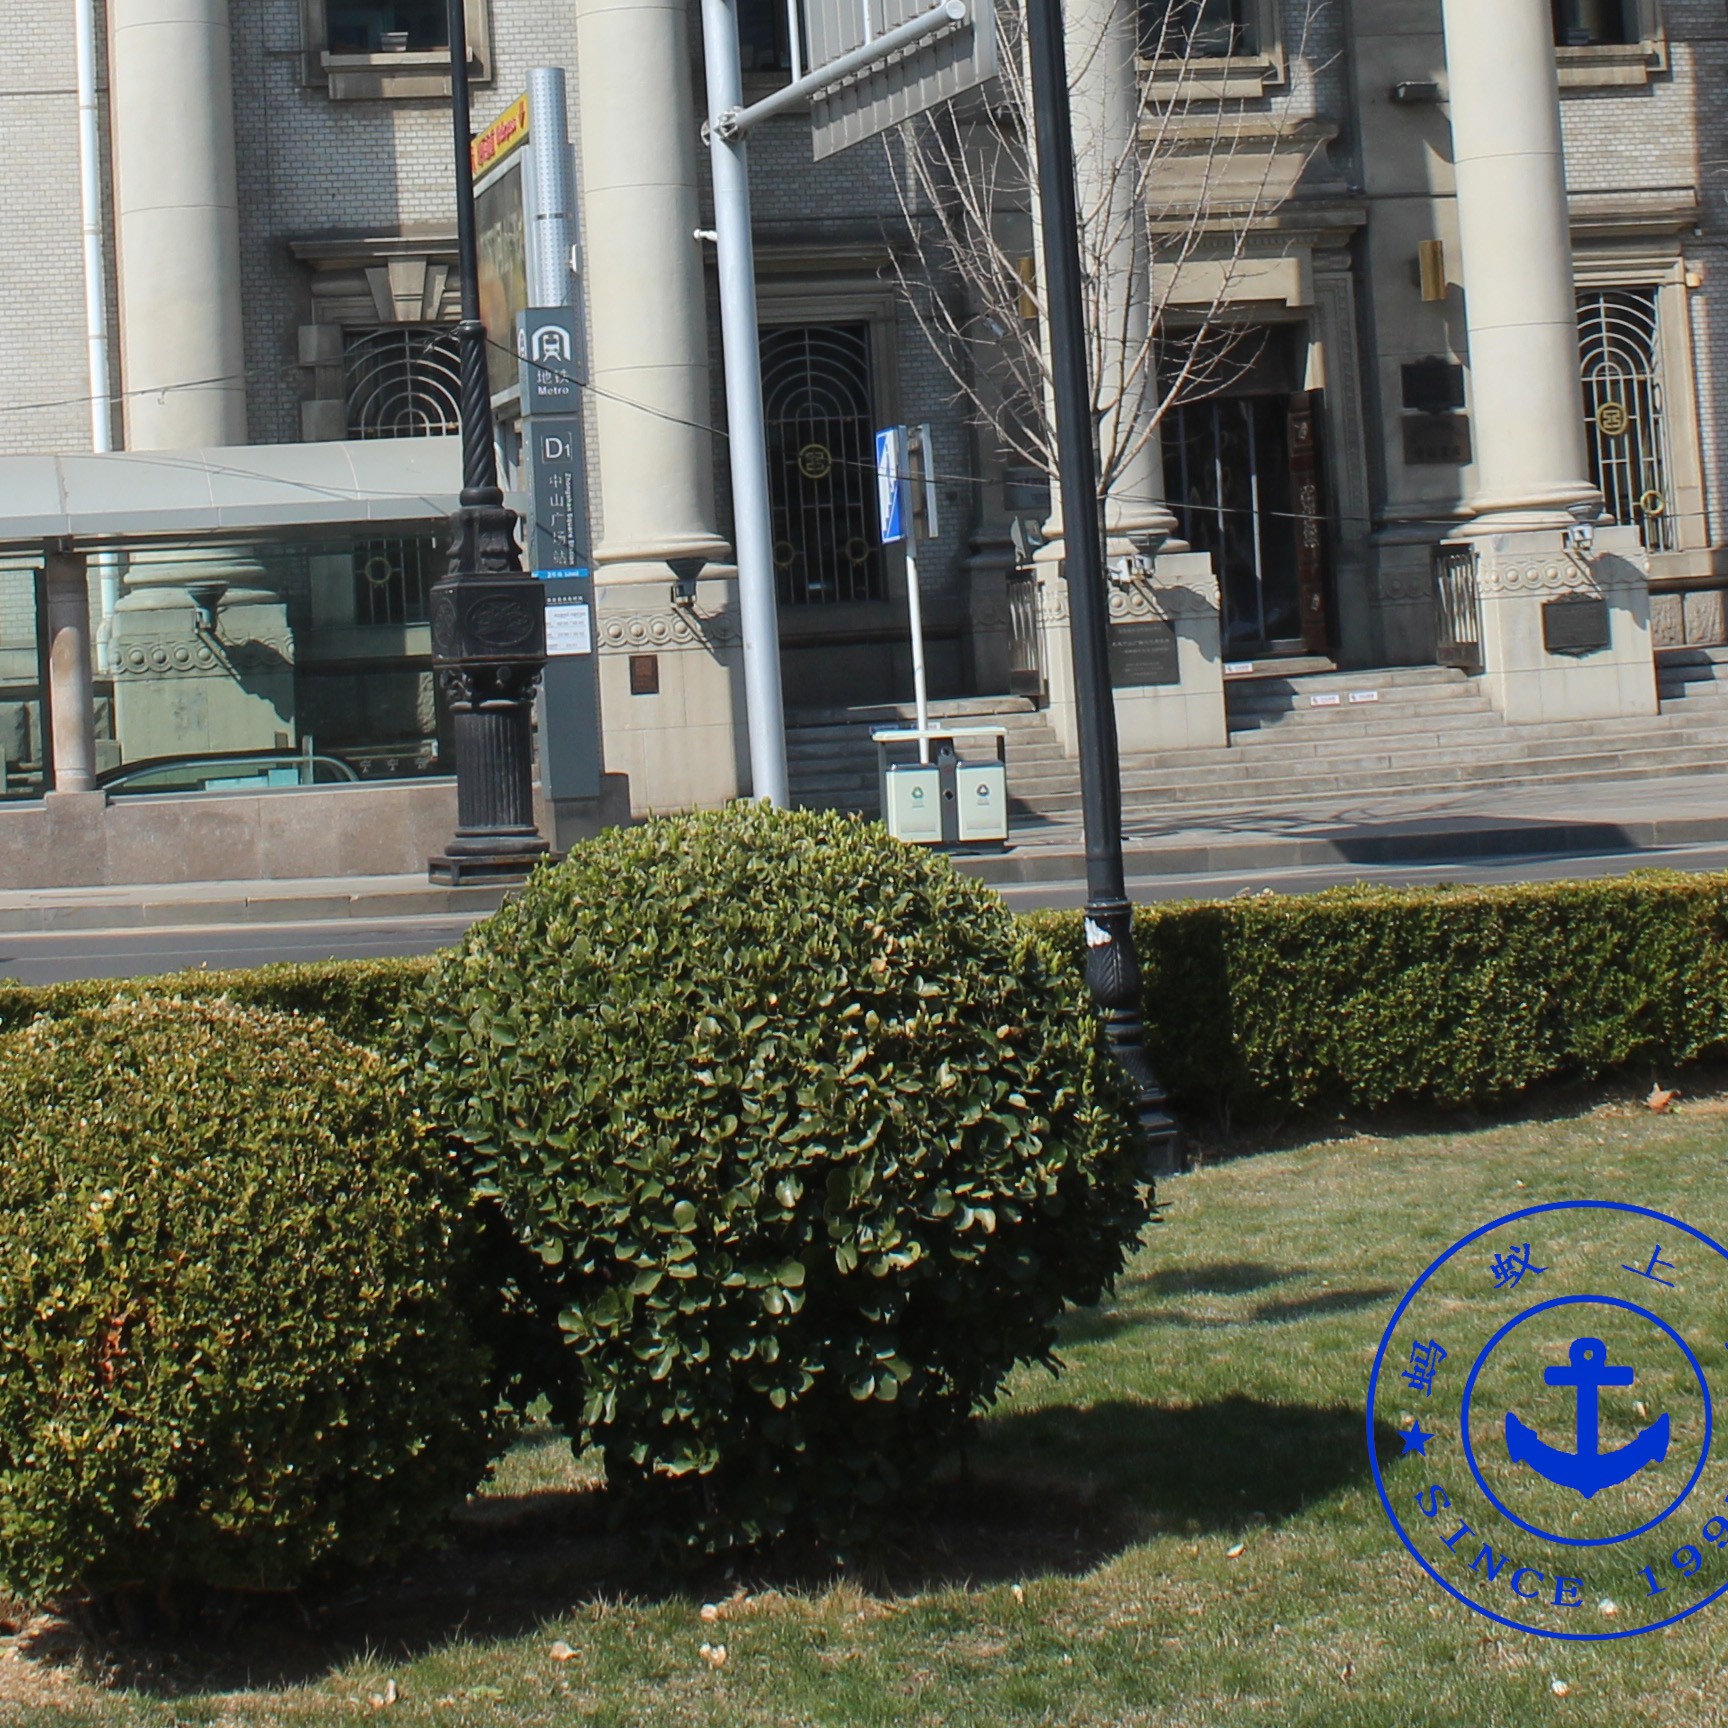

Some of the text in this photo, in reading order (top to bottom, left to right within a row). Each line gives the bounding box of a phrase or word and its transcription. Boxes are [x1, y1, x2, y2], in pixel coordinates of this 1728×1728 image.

[536, 368, 569, 384] 地铁
[537, 385, 569, 396] Metro
[545, 437, 571, 459] D1
